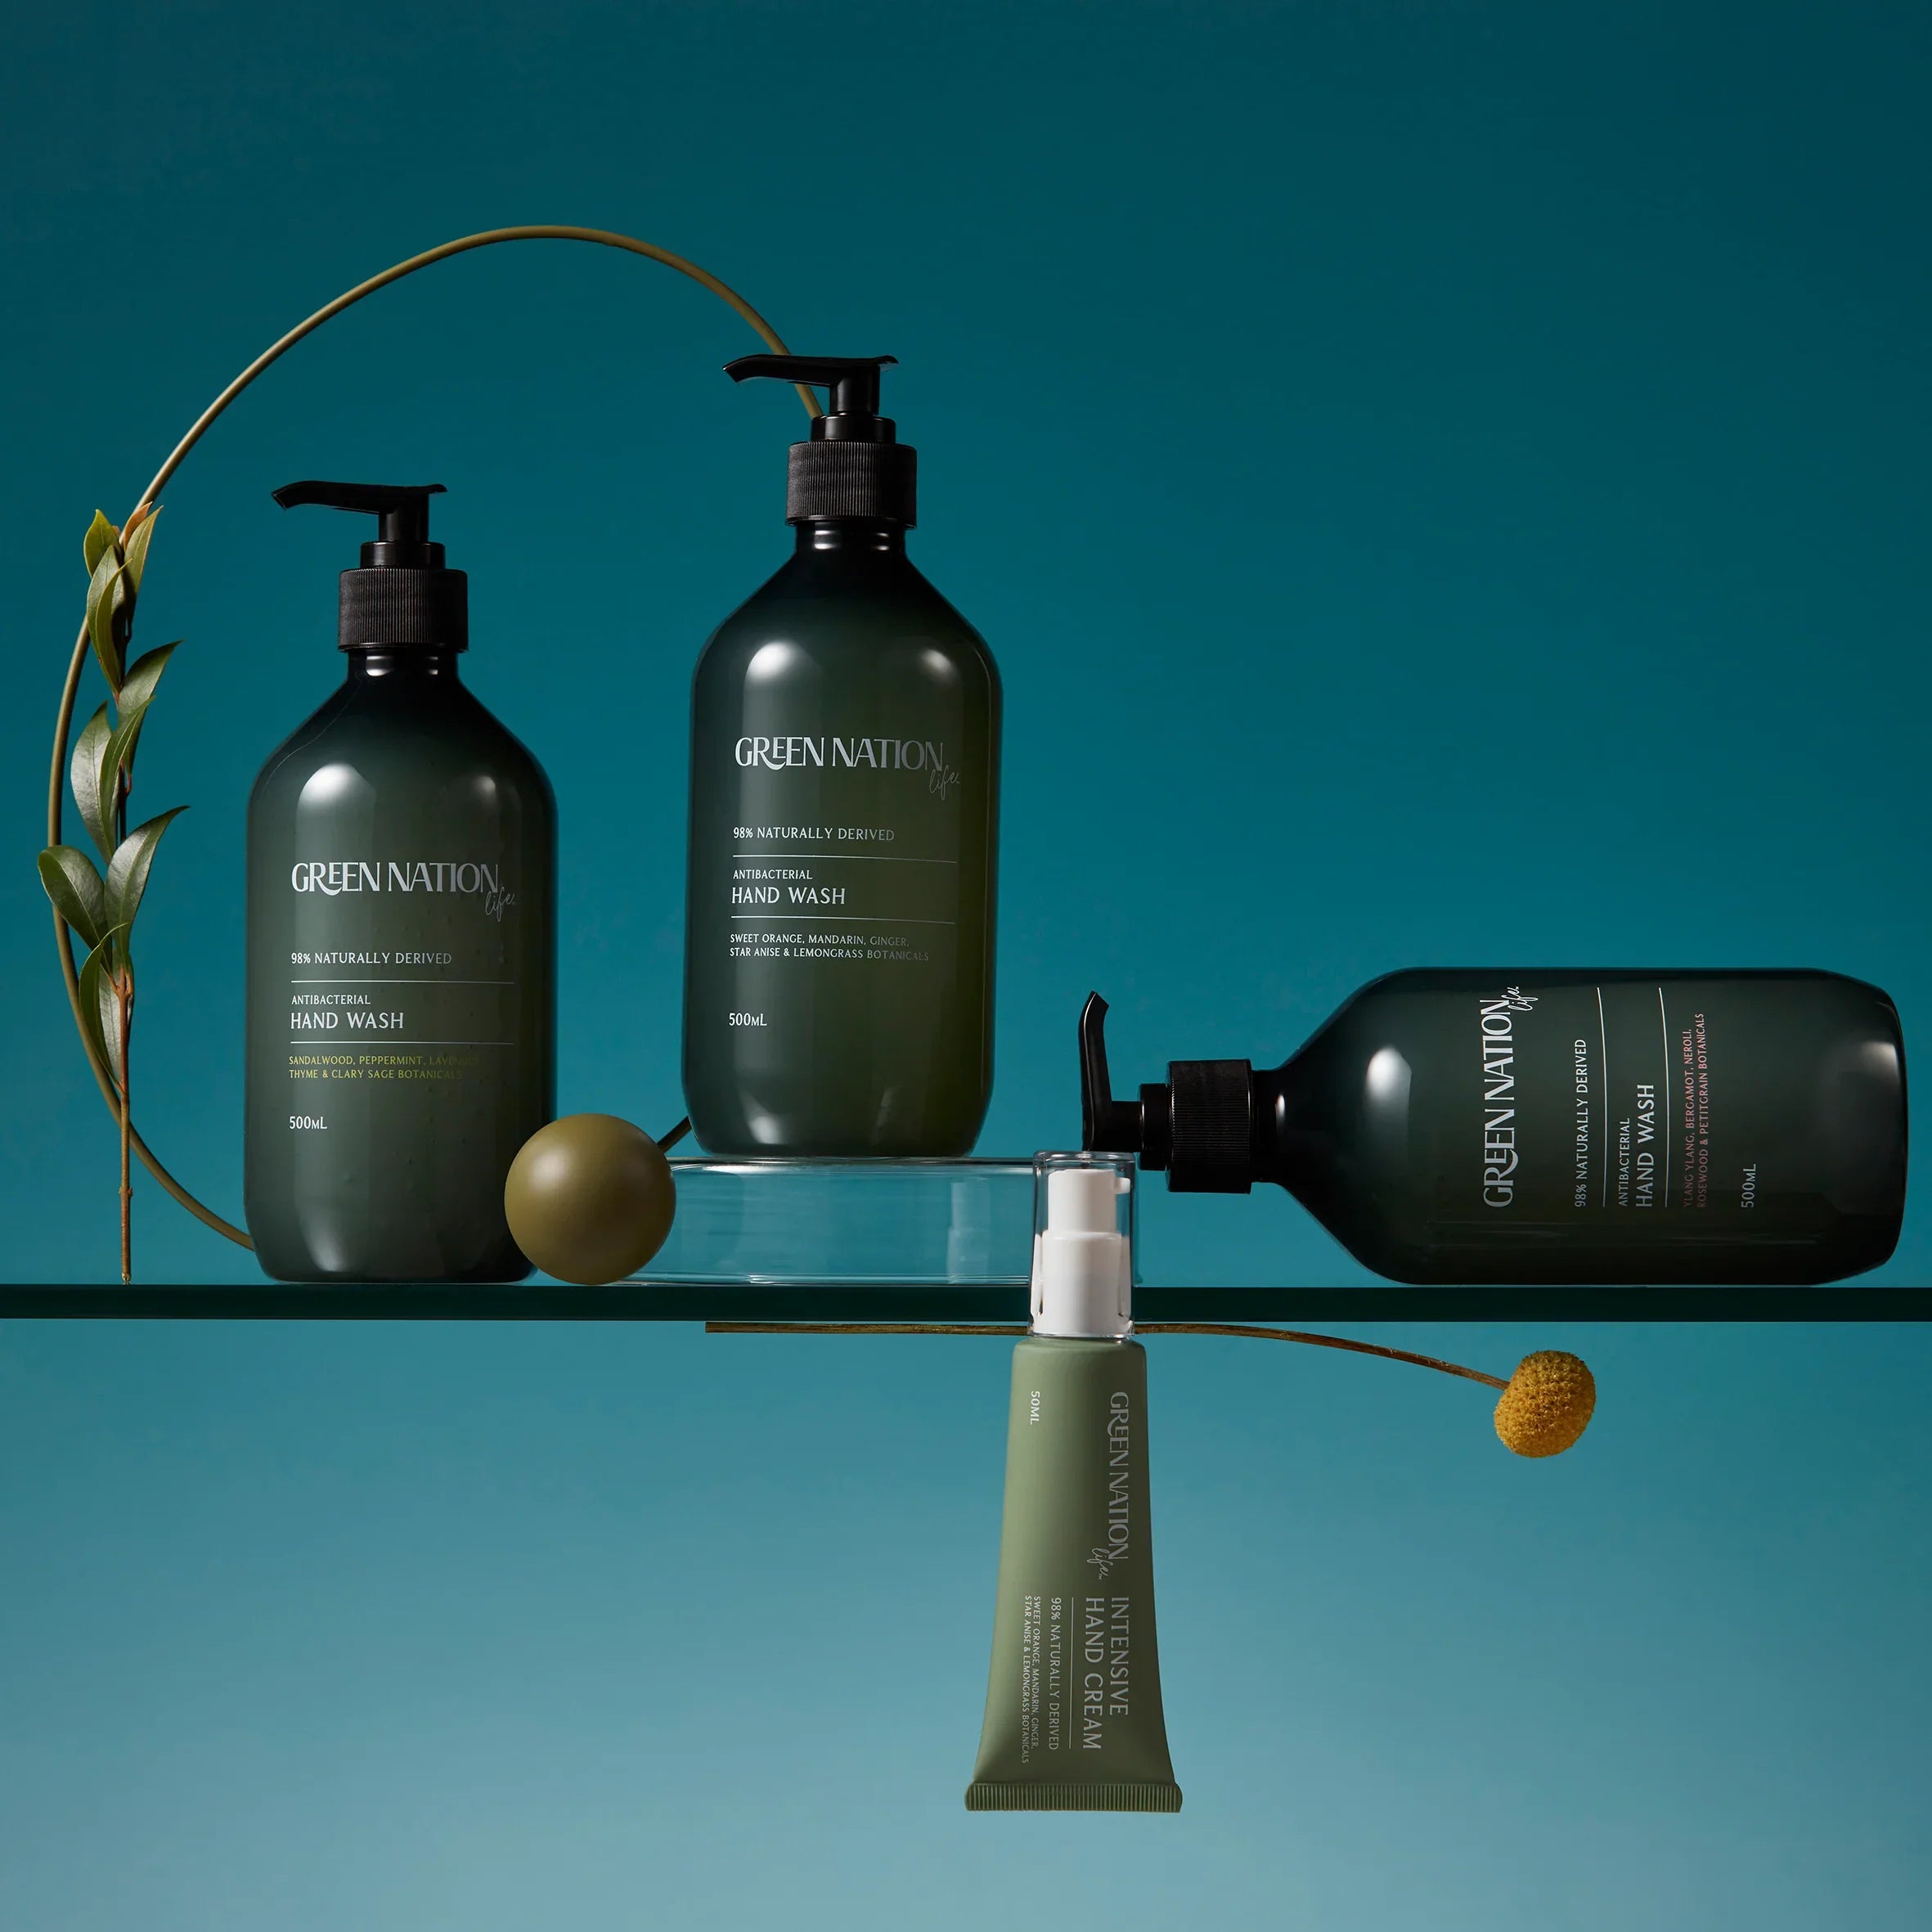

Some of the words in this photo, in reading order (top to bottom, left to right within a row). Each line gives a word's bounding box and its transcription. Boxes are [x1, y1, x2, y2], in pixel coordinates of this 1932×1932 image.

[735, 736, 824, 771] GREEN
[832, 737, 943, 771] NATION
[733, 827, 753, 838] 98%
[757, 827, 833, 839] NATURALLY
[838, 828, 895, 841] DERIVED
[291, 862, 380, 896] GREEN
[389, 862, 498, 893] NATION
[733, 869, 813, 880] ANTIBACTERIAL
[731, 887, 780, 904] HAND
[788, 887, 846, 905] WASH
[291, 953, 311, 964] 98%
[315, 952, 389, 964] NATURALLY
[395, 953, 452, 964] DERIVED
[730, 933, 759, 943] SWEET
[762, 934, 805, 945] ORANGE,
[808, 934, 866, 946] MANDARIN,
[730, 947, 751, 957] STAR
[753, 948, 780, 957] ANISE
[783, 948, 790, 957] &
[793, 948, 863, 959] LEMONGRASS
[867, 950, 929, 961] BOTANICALS
[291, 995, 371, 1005] ANTIBACTERIAL
[290, 1012, 339, 1029] HAND
[347, 1012, 404, 1029] WASH
[1480, 1000, 1515, 1101] NATION
[1695, 1013, 1707, 1069] BOTANICALS
[289, 1056, 356, 1067] SANDALWOOD,
[359, 1056, 426, 1067] PEPPERMINT,
[289, 1069, 318, 1079] THYME
[322, 1069, 329, 1079] &
[331, 1069, 364, 1079] CLARY
[367, 1069, 394, 1079] SAGE
[398, 1069, 463, 1080] BOTANICALS
[1575, 1039, 1588, 1094] DERIVED
[1637, 1085, 1654, 1143] WASH
[1685, 1068, 1695, 1129] BERGAMOT,
[1699, 1073, 1709, 1134] PETITGRAIN
[1483, 1108, 1518, 1207] GREEN
[1575, 1099, 1588, 1179] NATURALLY
[1685, 1133, 1695, 1170] YLANG,
[1618, 1117, 1630, 1206] ANTIBACTERIAL
[1636, 1152, 1653, 1207] HAND
[1696, 1149, 1709, 1208] ROSEWOOD
[1575, 1184, 1587, 1207] 98%
[1683, 1175, 1694, 1208] YLANG
[1029, 1391, 1041, 1426] 50ML
[1107, 1391, 1130, 1467] GREEN
[1108, 1472, 1130, 1560] NATION
[1024, 1595, 1032, 1617] STAR
[1032, 1596, 1041, 1626] SWEET
[1050, 1597, 1062, 1620] 98%
[1023, 1620, 1031, 1644] ANISE
[1031, 1628, 1040, 1666] ORANGE,
[1085, 1597, 1104, 1663] HAND
[1049, 1624, 1061, 1698] NATURALLY
[1110, 1597, 1130, 1716] INTENSIVE
[1022, 1656, 1031, 1712] LEMONGRASS
[1031, 1669, 1040, 1715] MANDARIN,
[1048, 1703, 1060, 1750] DERIVED
[1083, 1674, 1103, 1750] CREAM
[1021, 1714, 1030, 1764] BOTANICALS
[1031, 1718, 1040, 1750] GINGER,
